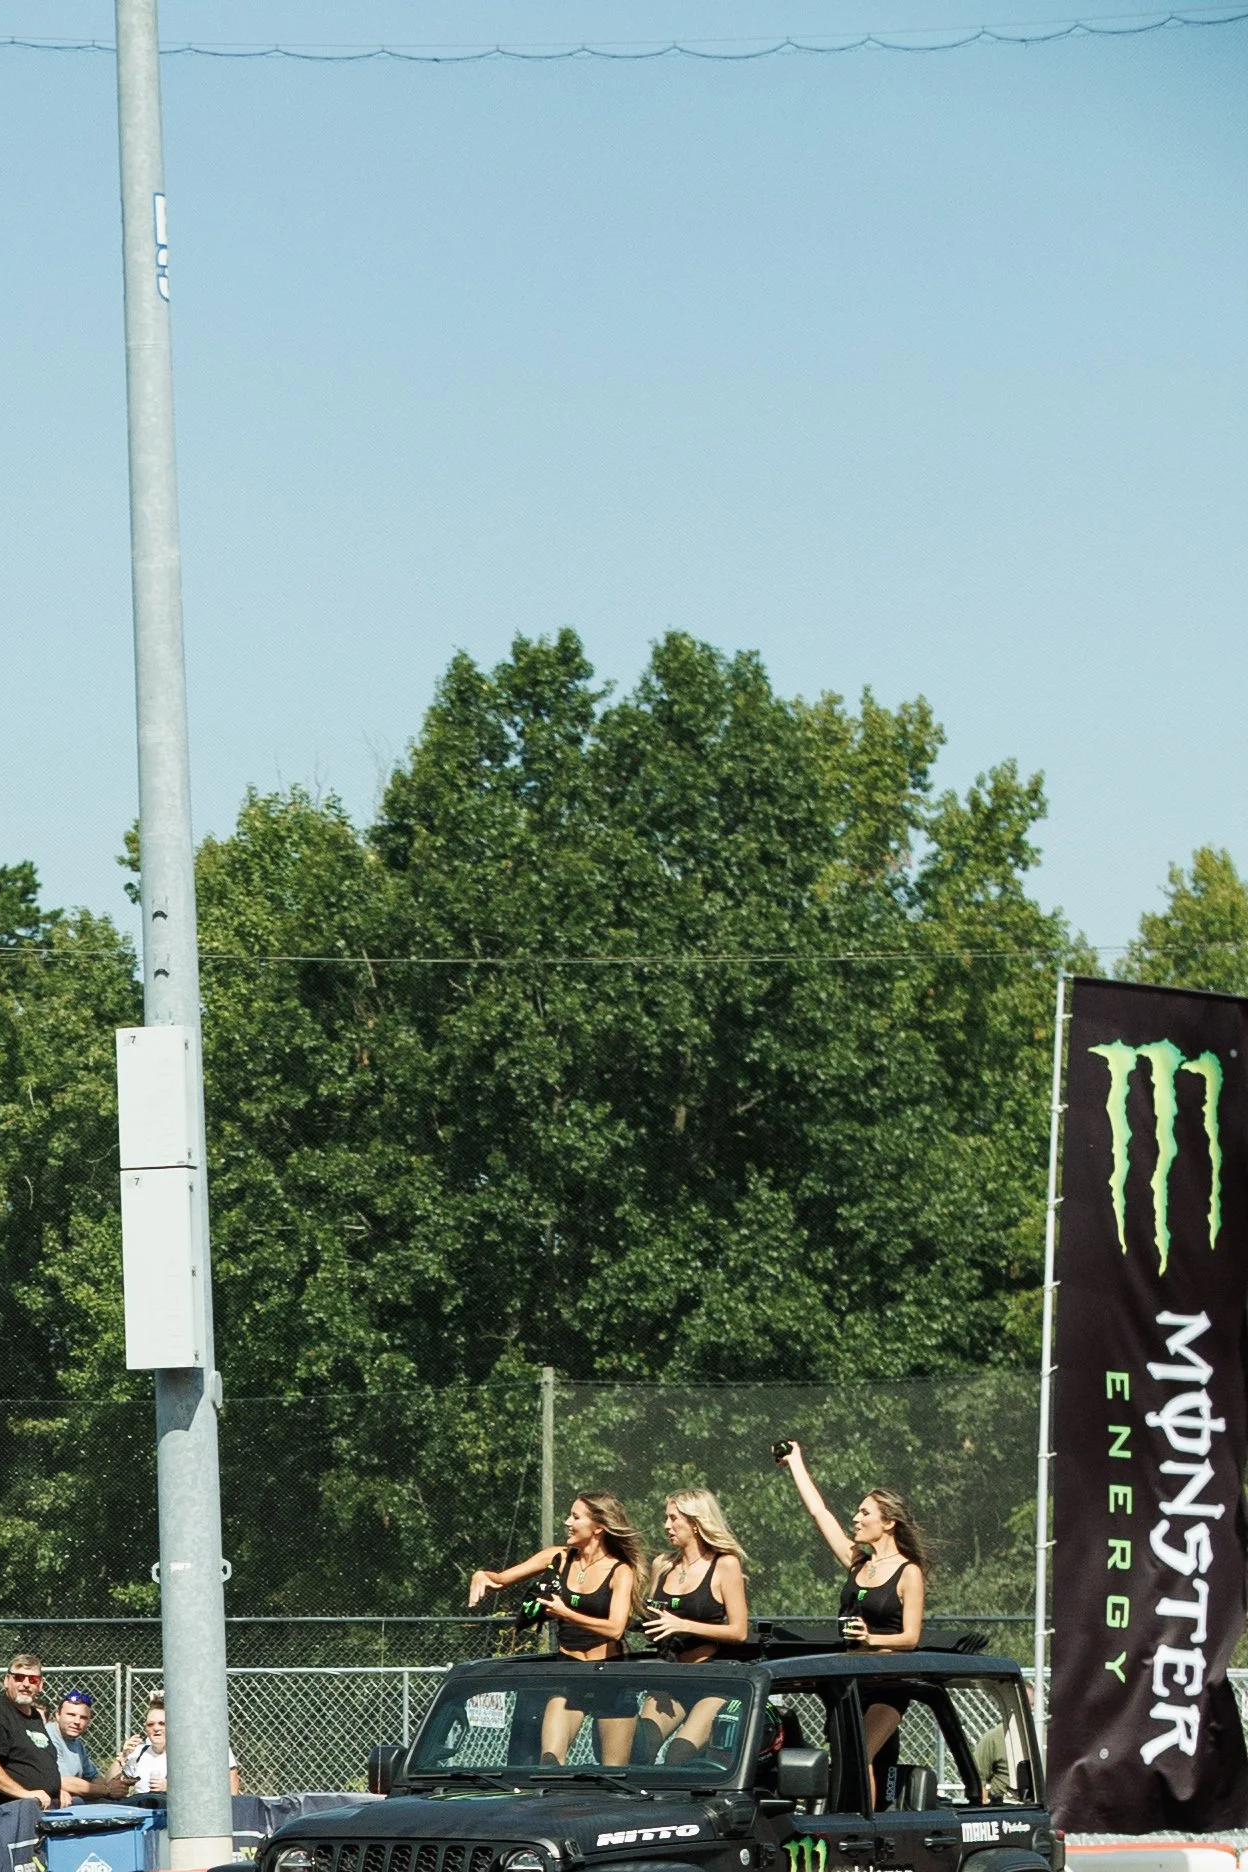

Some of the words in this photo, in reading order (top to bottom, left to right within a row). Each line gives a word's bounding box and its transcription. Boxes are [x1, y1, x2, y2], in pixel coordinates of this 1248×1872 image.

[1104, 1370, 1134, 1684] ENERGY
[1140, 1309, 1227, 1766] MONSTER
[596, 1824, 701, 1847] NITTO
[961, 1820, 1000, 1843] MAHLE
